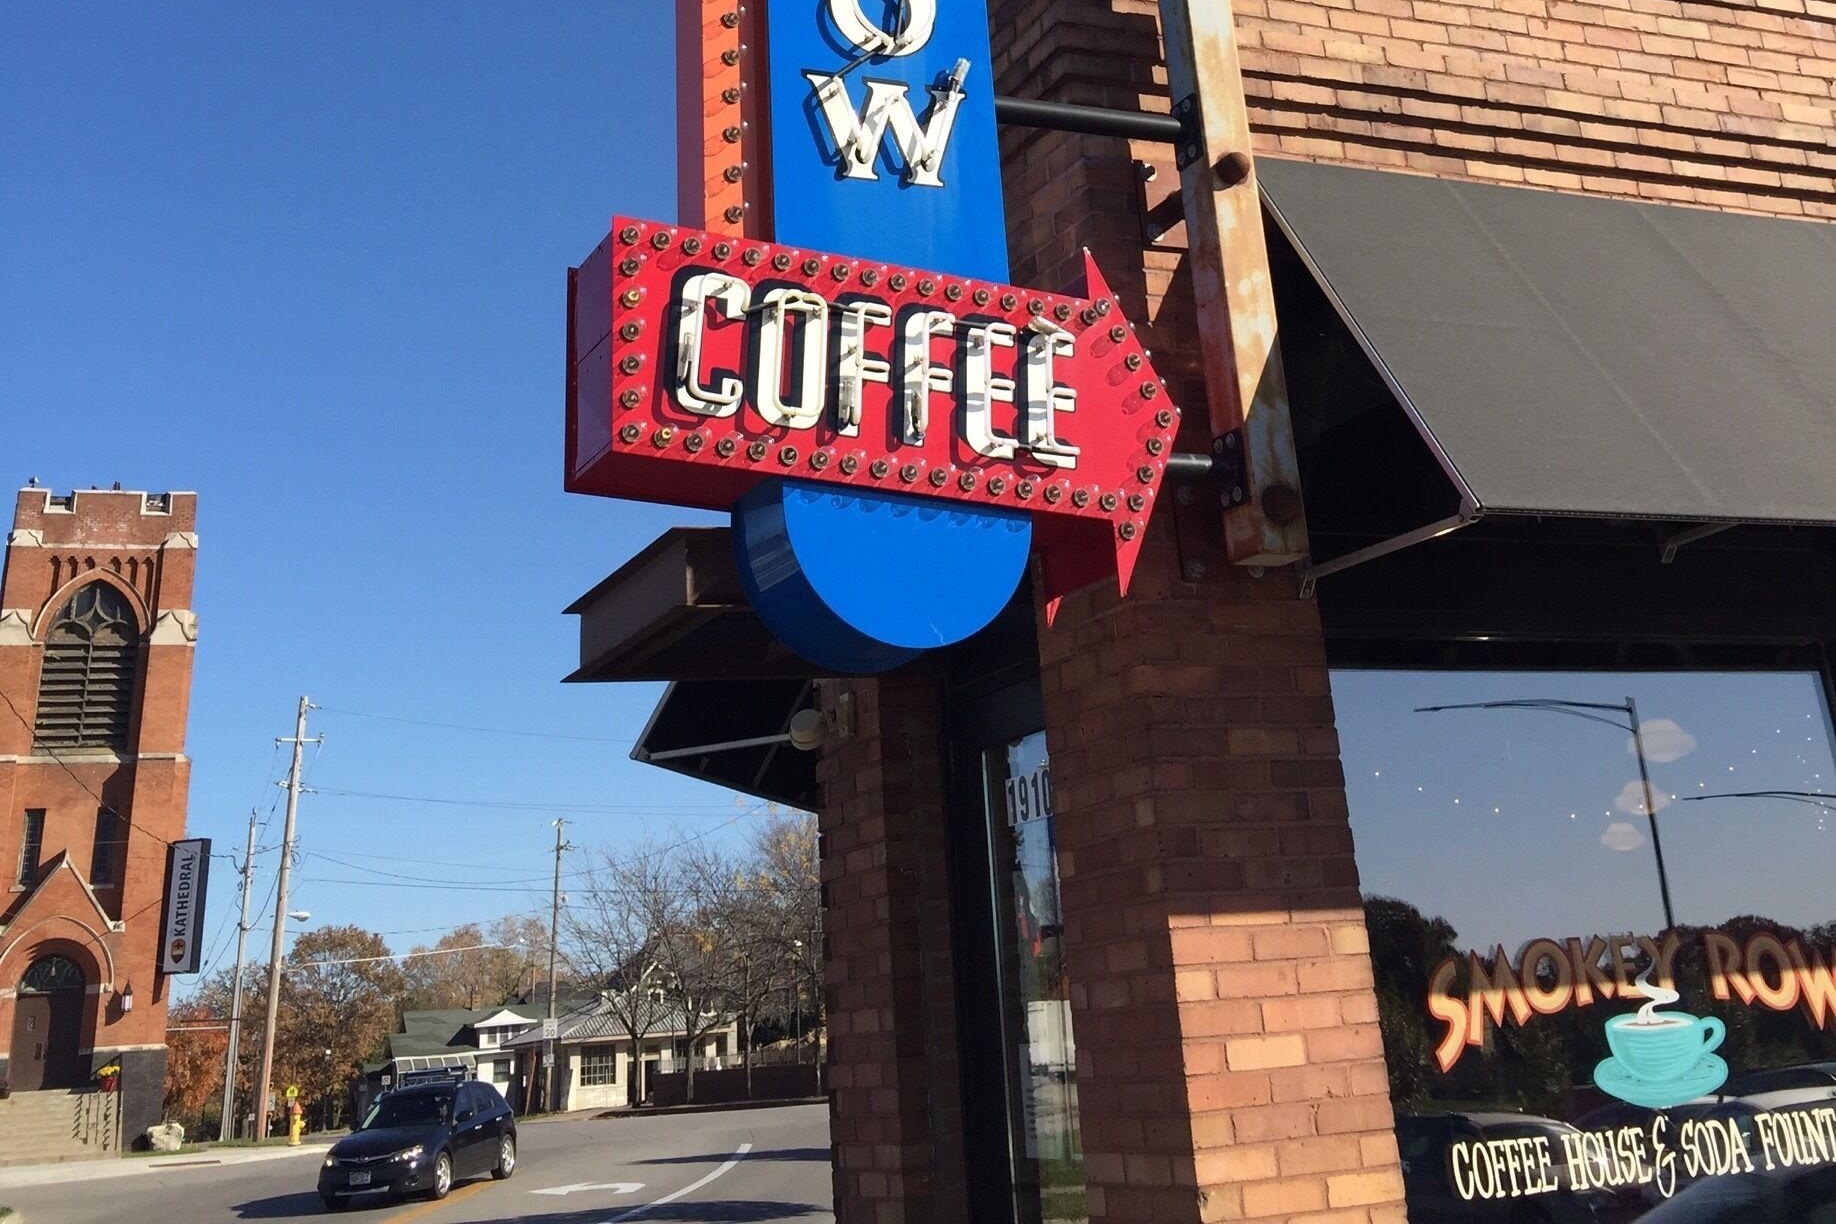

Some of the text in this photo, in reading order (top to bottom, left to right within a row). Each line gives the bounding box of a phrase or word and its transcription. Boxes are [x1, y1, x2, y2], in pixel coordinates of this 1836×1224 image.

[675, 272, 1082, 469] COFFEE
[1008, 769, 1051, 824] 1910
[174, 854, 194, 937] KATHEDRAL
[1427, 930, 1836, 1074] SMOKEY ROW
[1452, 1136, 1558, 1200] COFFEE
[1560, 1126, 1652, 1191] HOUSE
[1652, 1115, 1677, 1199] &
[1680, 1117, 1755, 1178] SODA
